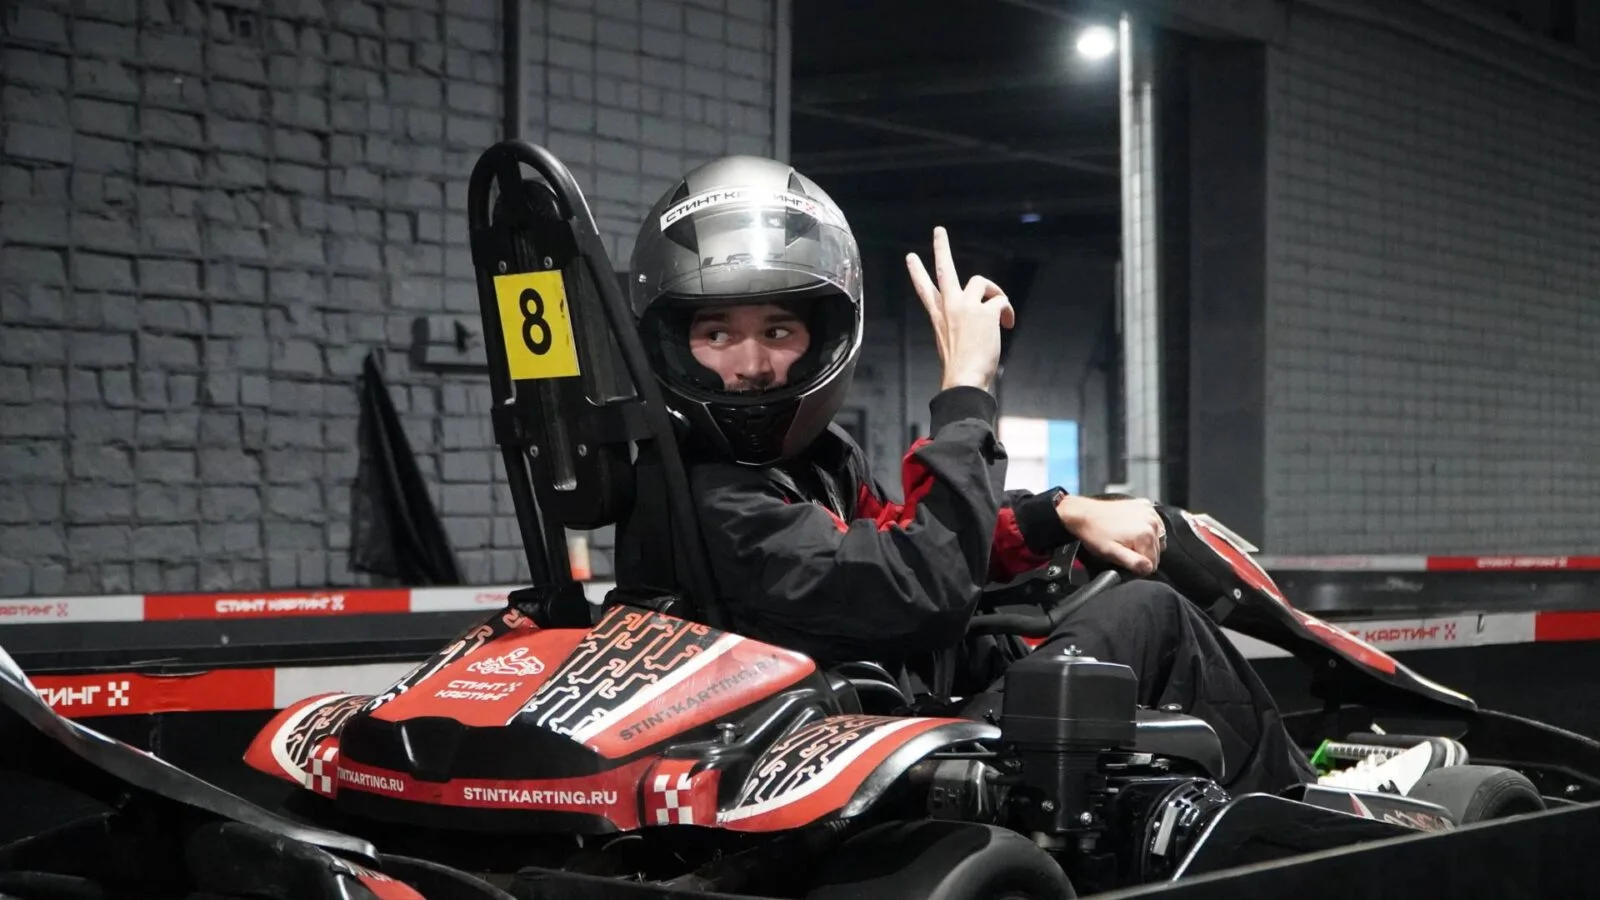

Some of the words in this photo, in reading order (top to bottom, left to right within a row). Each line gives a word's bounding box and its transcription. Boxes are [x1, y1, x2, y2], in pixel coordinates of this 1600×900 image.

[665, 192, 722, 222] СТИНТ
[724, 191, 803, 207] КИНГ
[519, 287, 553, 356] 8
[447, 679, 504, 691] СТИНТ
[337, 766, 404, 793] TINTKARTING.RU
[463, 786, 618, 805] STINTKARTING.RU
